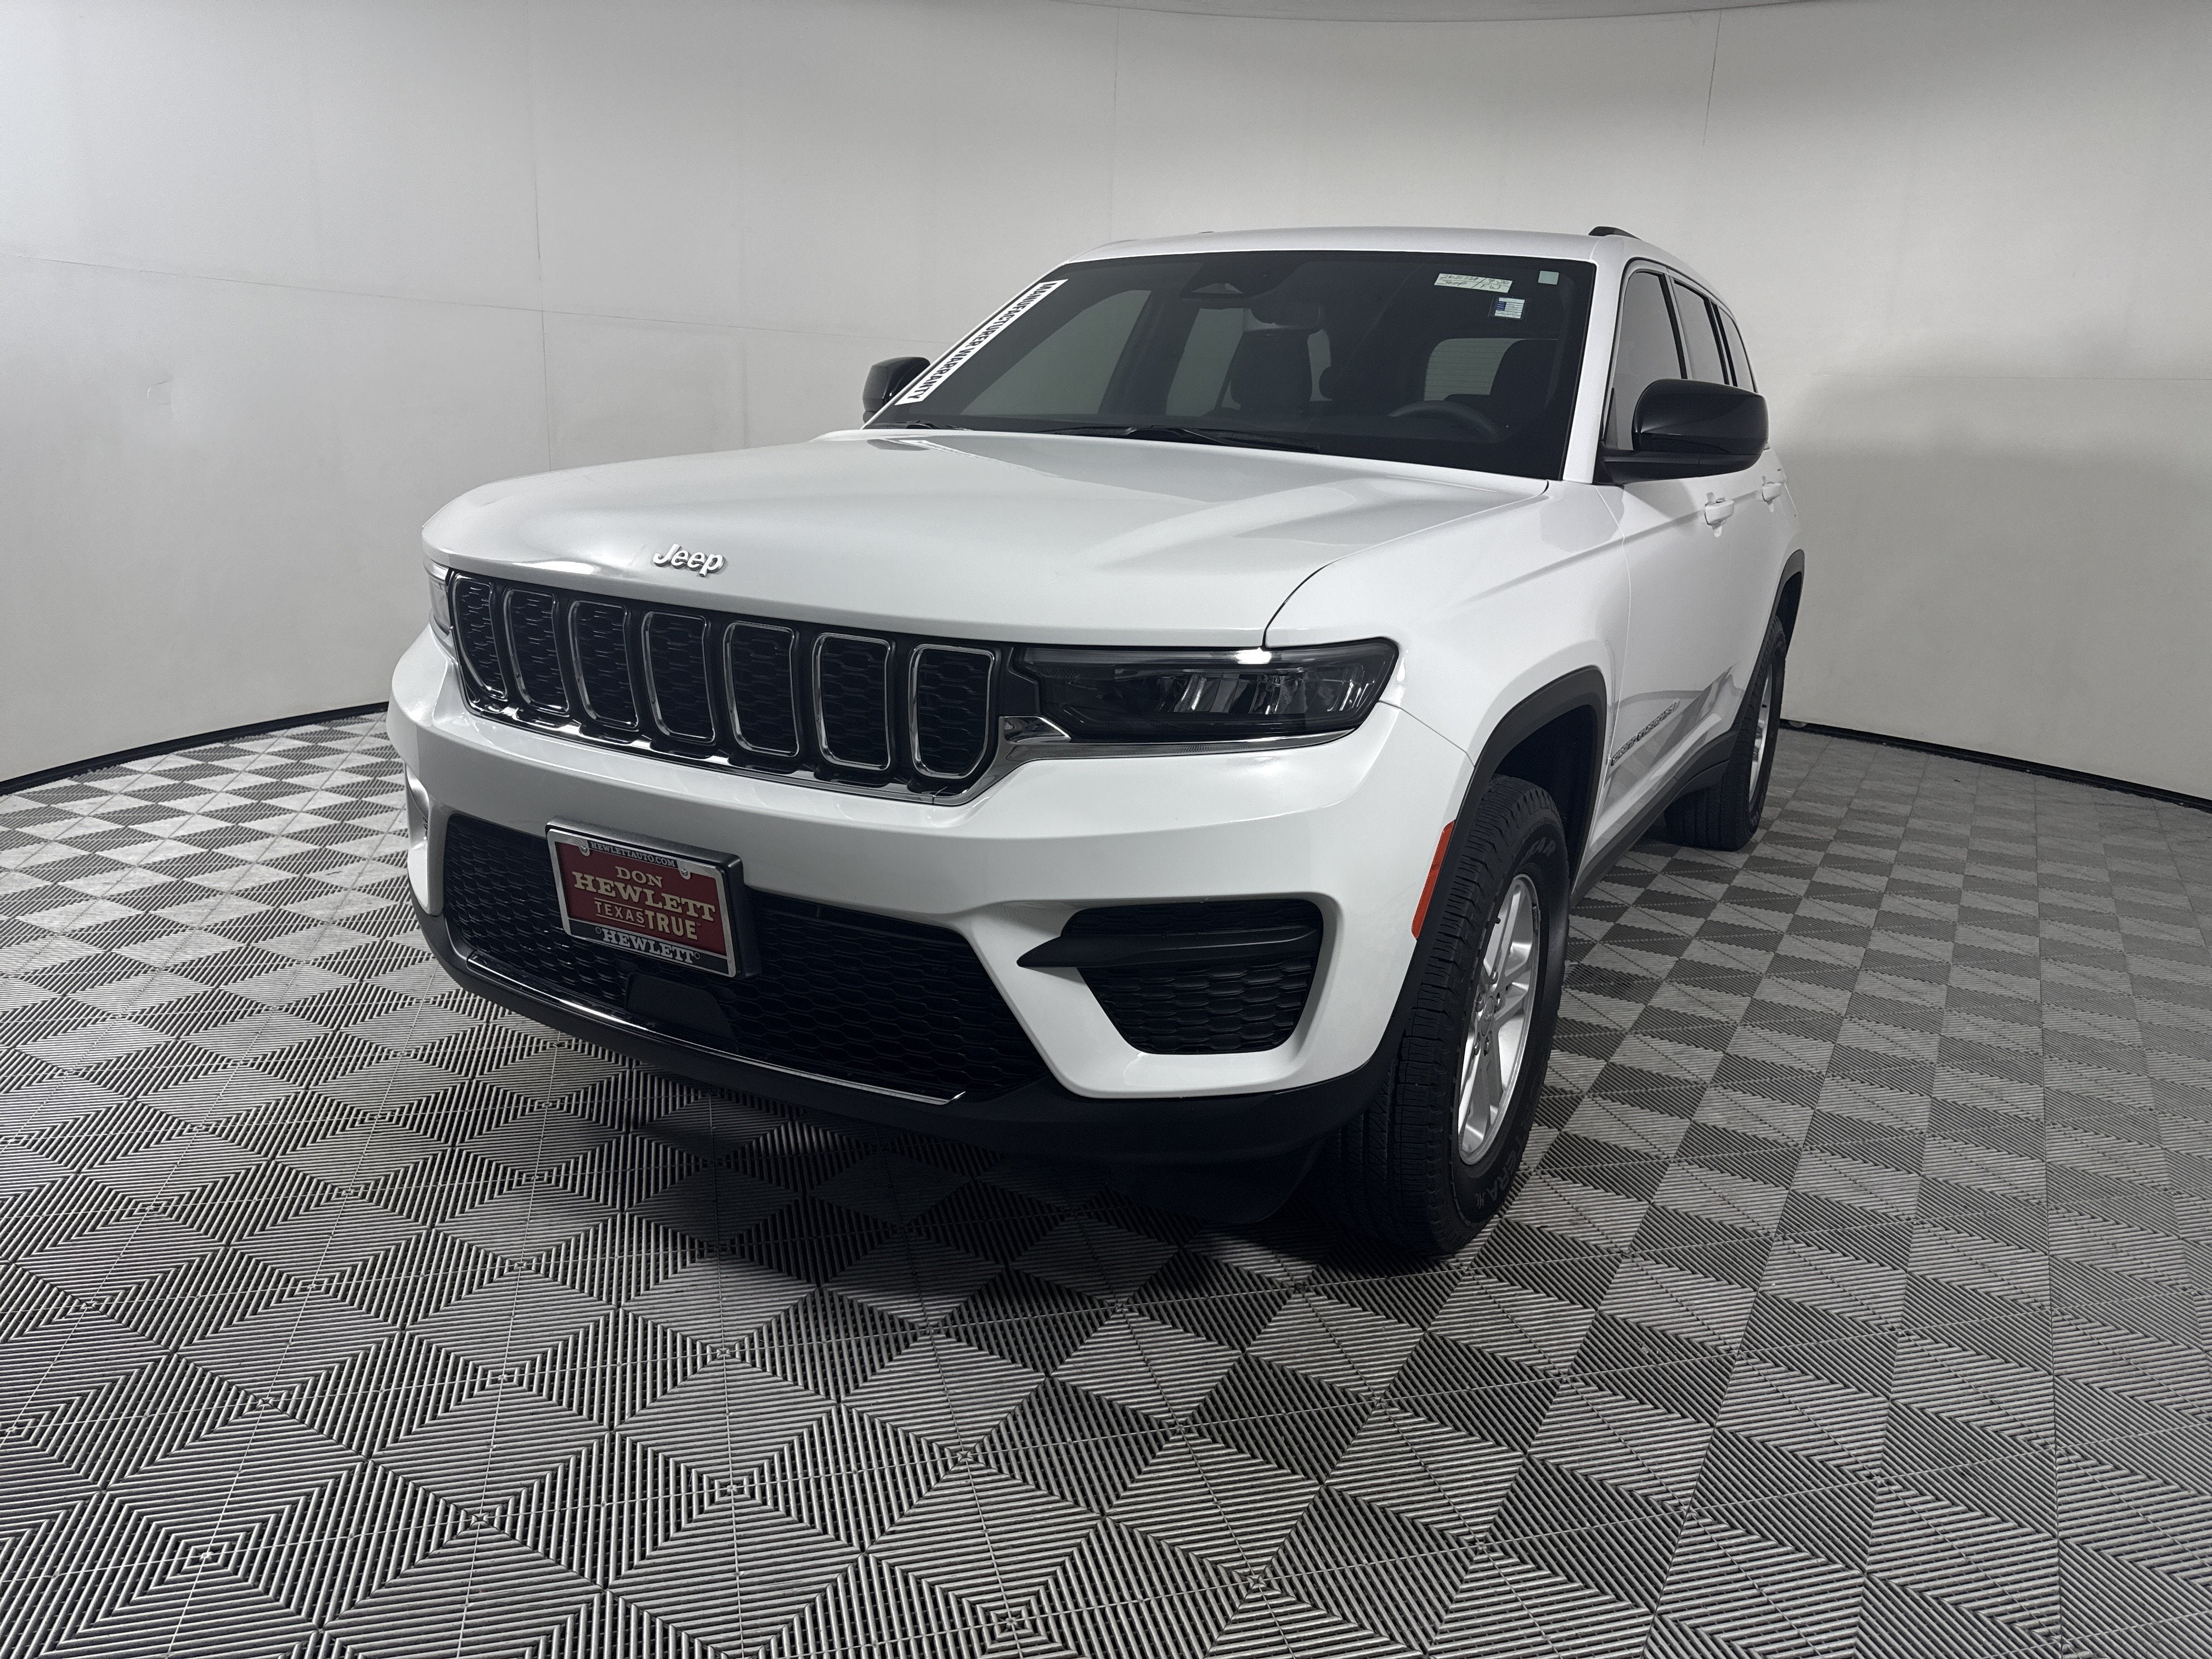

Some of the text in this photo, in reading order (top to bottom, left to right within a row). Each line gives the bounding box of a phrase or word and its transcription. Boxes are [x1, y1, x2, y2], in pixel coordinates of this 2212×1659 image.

[907, 282, 1058, 399] MANUFACTURER WARRANTY
[652, 543, 726, 578] Jeep
[590, 841, 676, 867] HEWLETTAUTO.COM
[615, 866, 663, 888] DON
[572, 871, 716, 922] HEWLETT
[602, 928, 695, 964] HEWLETT
